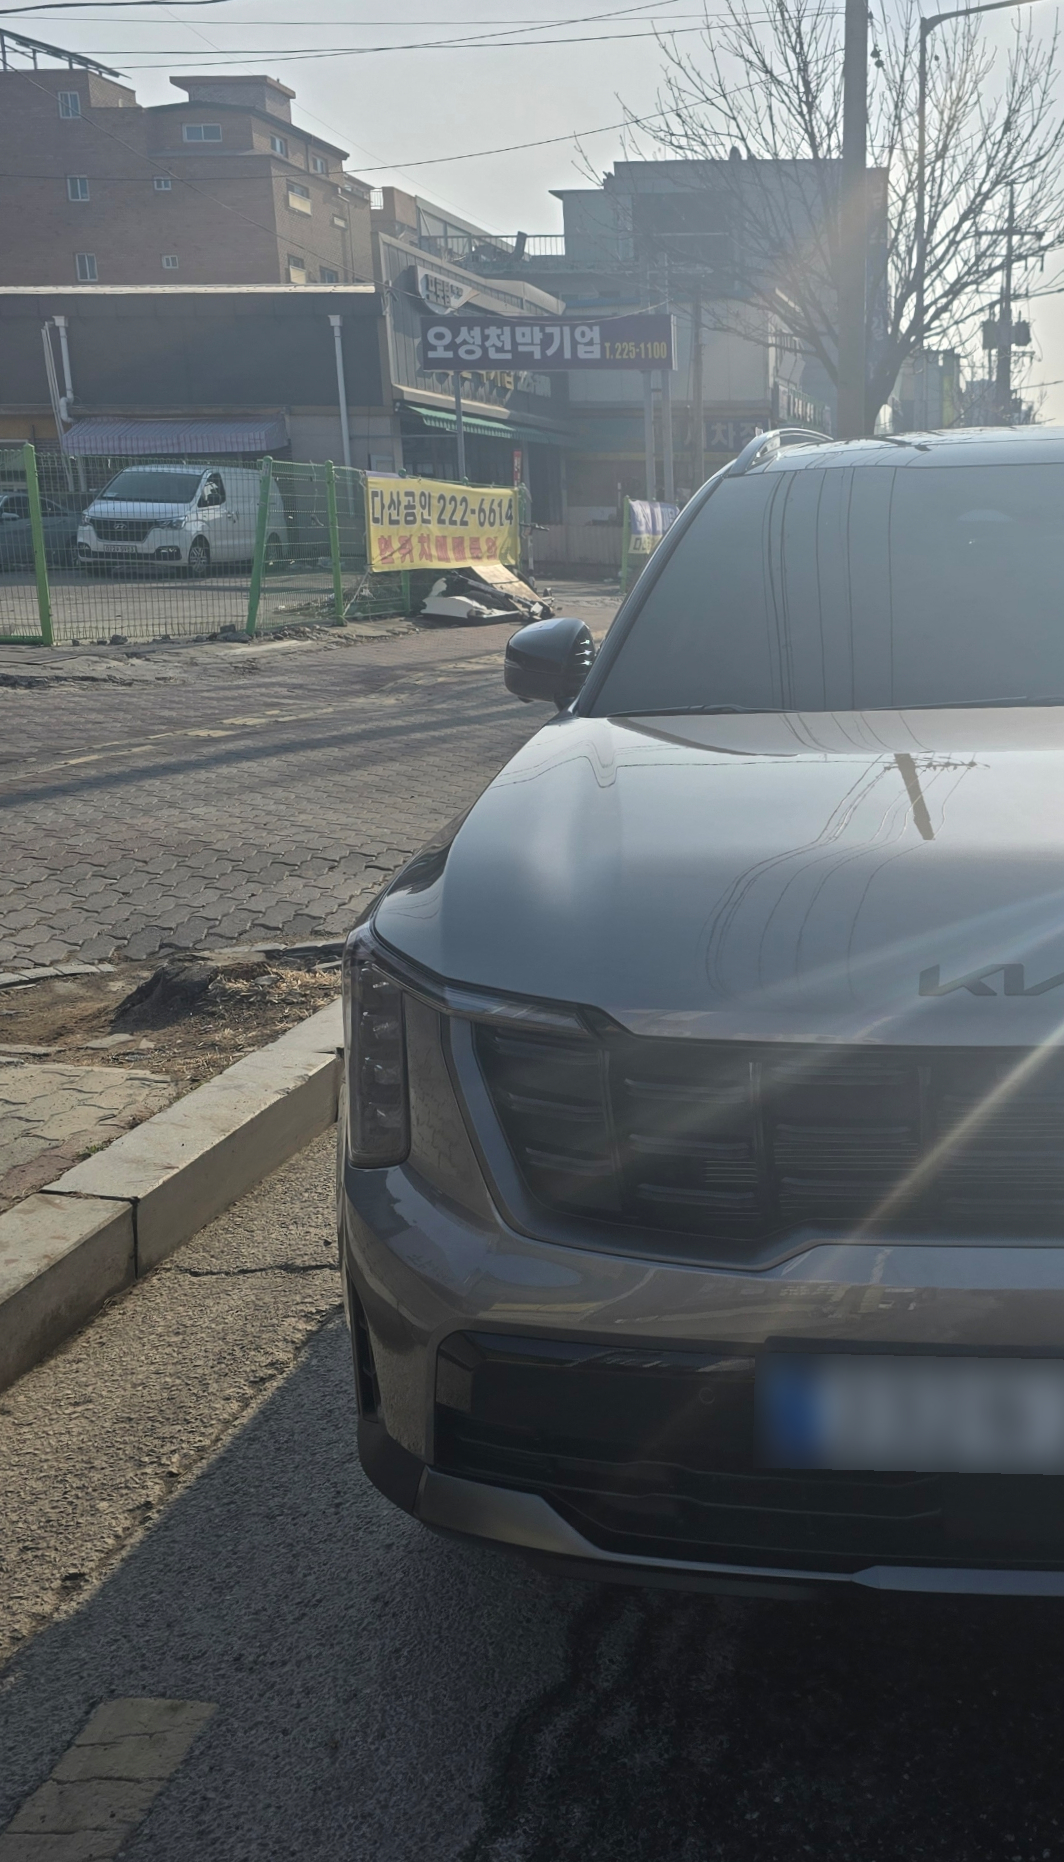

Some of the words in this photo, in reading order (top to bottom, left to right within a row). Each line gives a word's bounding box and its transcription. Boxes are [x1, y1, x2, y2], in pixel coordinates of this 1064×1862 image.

[426, 325, 602, 360] 오성천막기업
[371, 490, 432, 526] 다산공인
[436, 493, 514, 528] 222-6614
